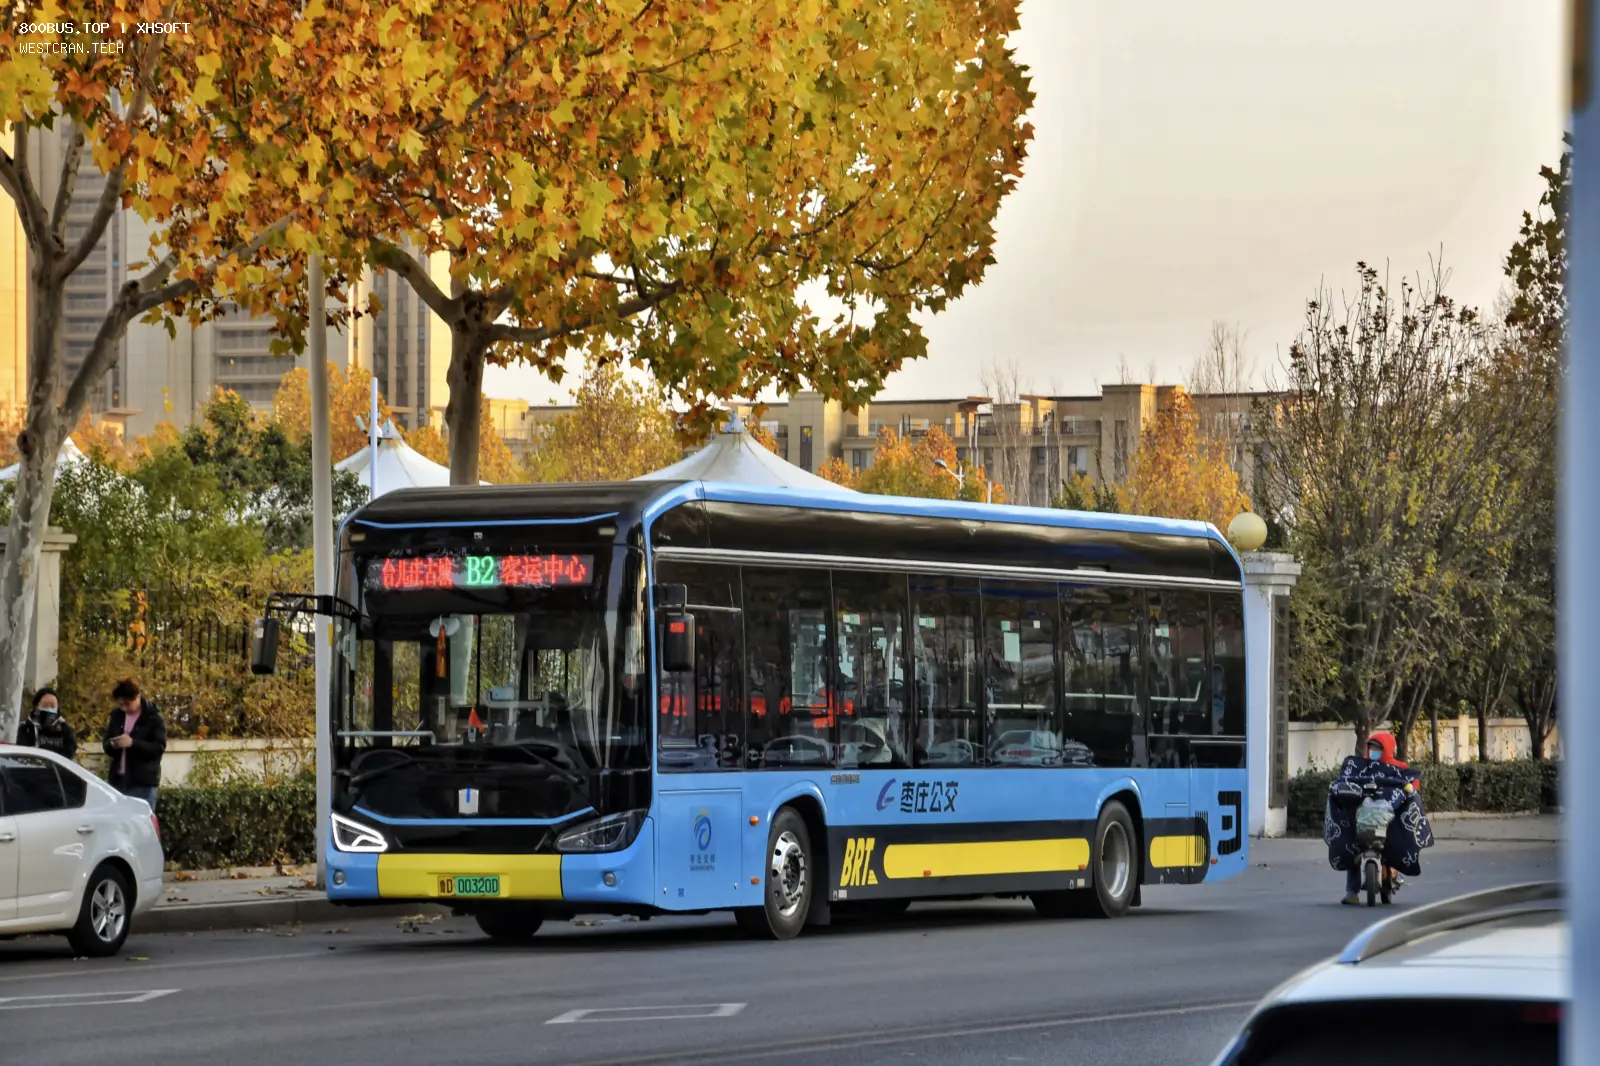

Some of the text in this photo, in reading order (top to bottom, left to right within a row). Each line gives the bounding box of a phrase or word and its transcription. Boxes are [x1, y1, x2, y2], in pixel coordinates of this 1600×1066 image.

[466, 555, 495, 585] B2
[501, 554, 587, 585] 客运中心
[900, 780, 959, 813] 枣庄公交
[840, 837, 876, 887] BRT
